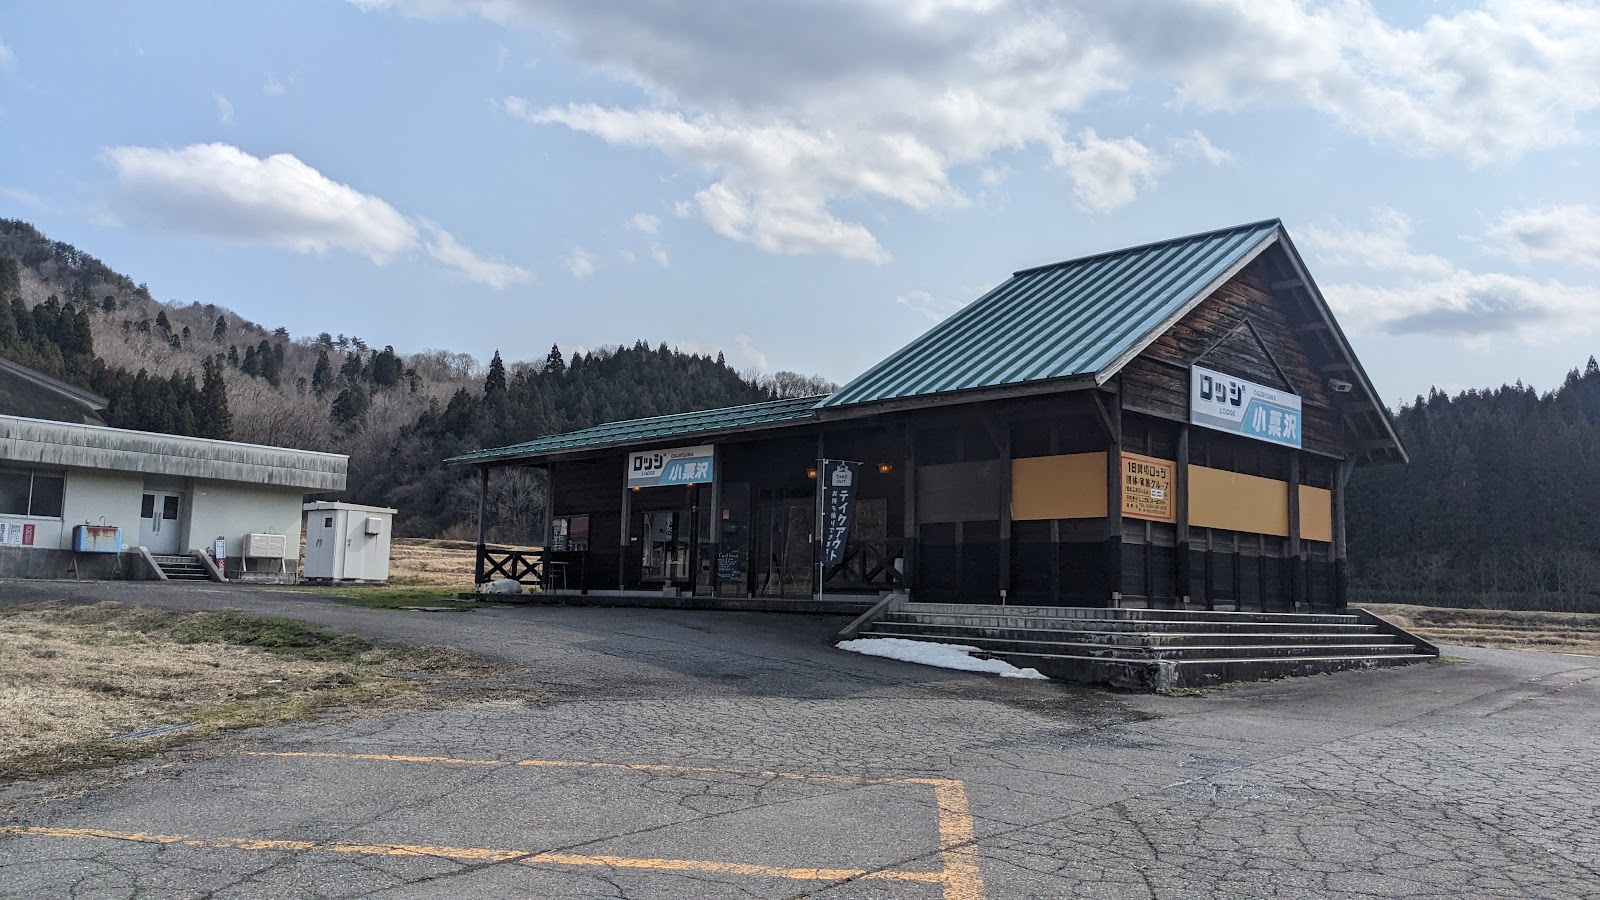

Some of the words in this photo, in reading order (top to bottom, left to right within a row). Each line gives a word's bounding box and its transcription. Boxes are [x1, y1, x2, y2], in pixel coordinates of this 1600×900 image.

[1200, 374, 1246, 407] ロッジ
[1219, 407, 1236, 417] LODGE
[633, 453, 667, 472] ロッジ
[830, 490, 849, 561] テイクアウト
